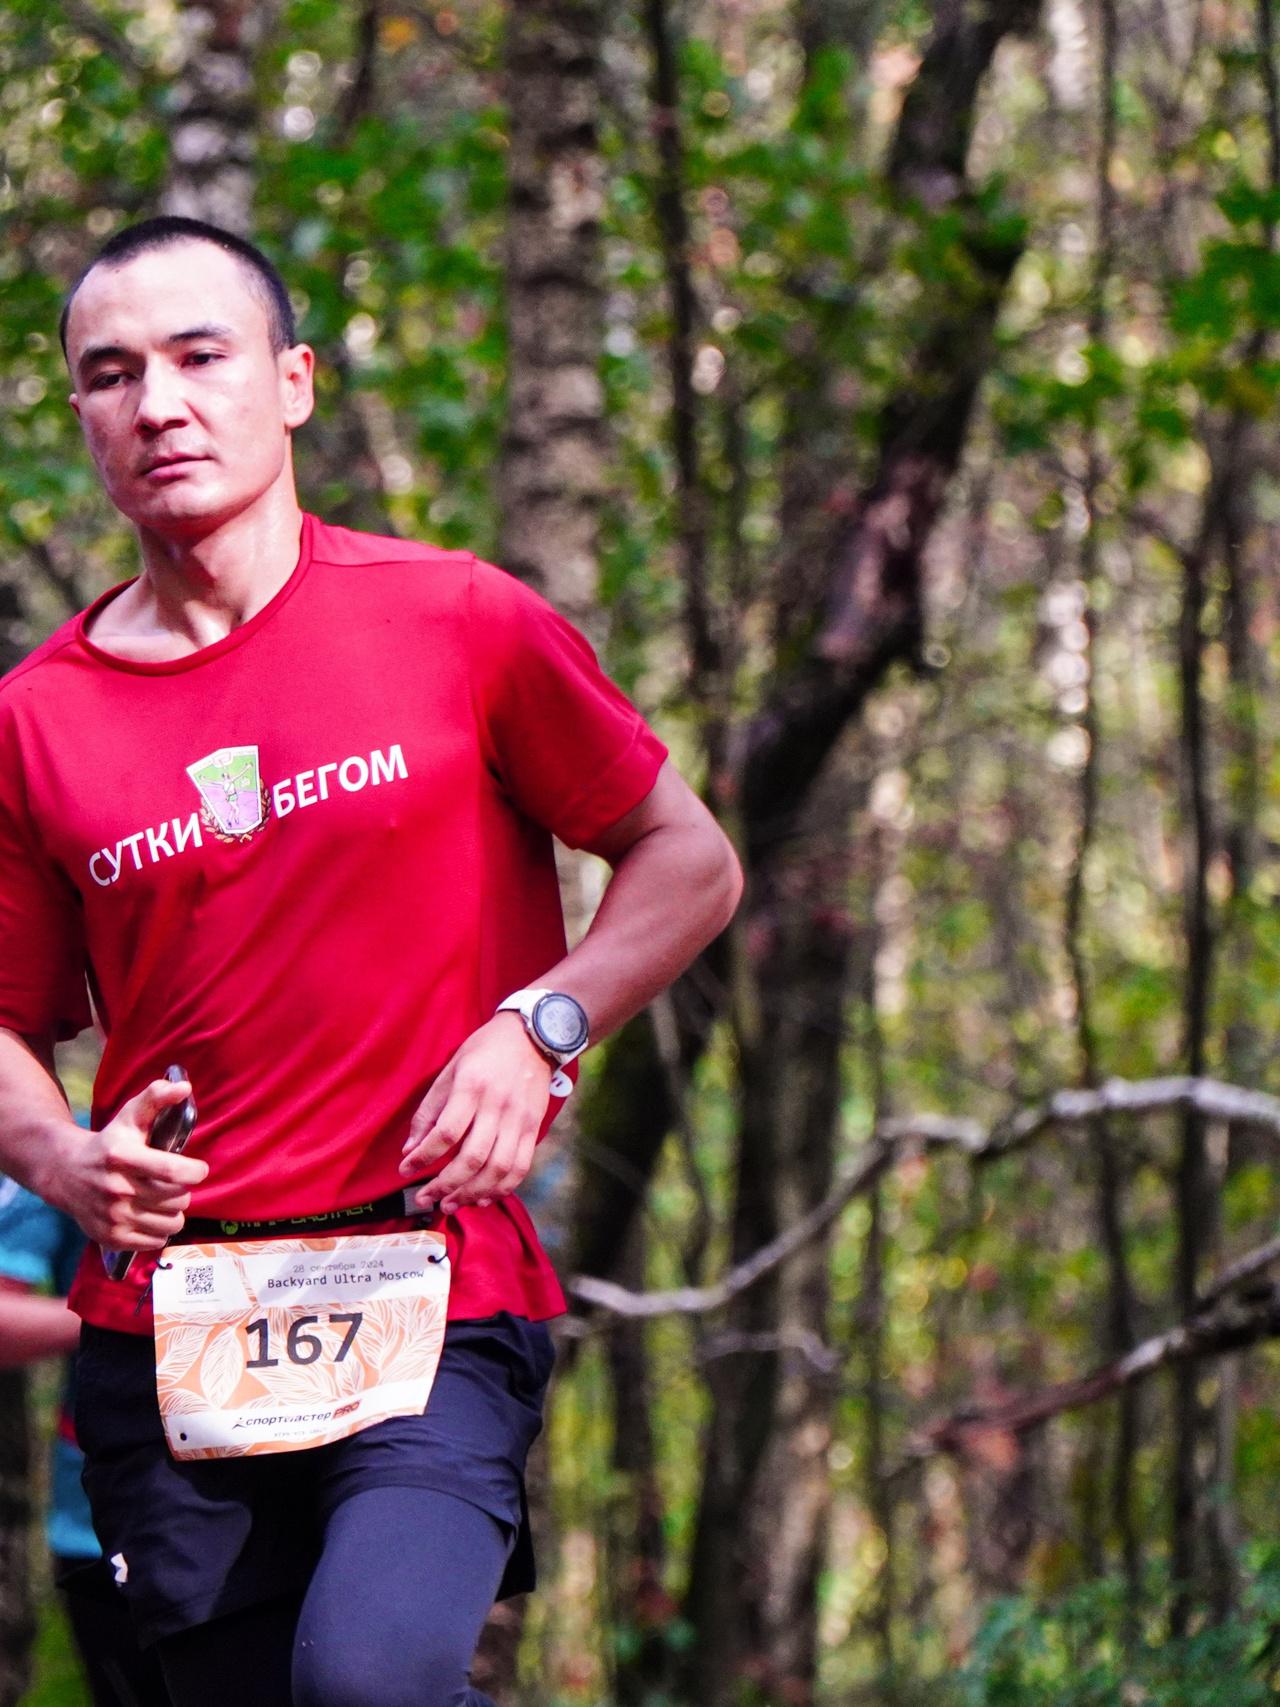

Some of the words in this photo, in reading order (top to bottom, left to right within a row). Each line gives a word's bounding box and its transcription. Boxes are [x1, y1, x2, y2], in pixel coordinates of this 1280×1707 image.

[89, 812, 204, 887] СУТКИ
[272, 744, 409, 819] БЕГОМ
[267, 1275, 327, 1290] Backyard
[334, 1273, 372, 1285] Ultra
[379, 1269, 425, 1282] Moscow
[292, 1264, 305, 1274] 28
[246, 1312, 363, 1369] 167
[245, 1411, 332, 1427] спортмастер
[333, 1401, 361, 1419] PRO
